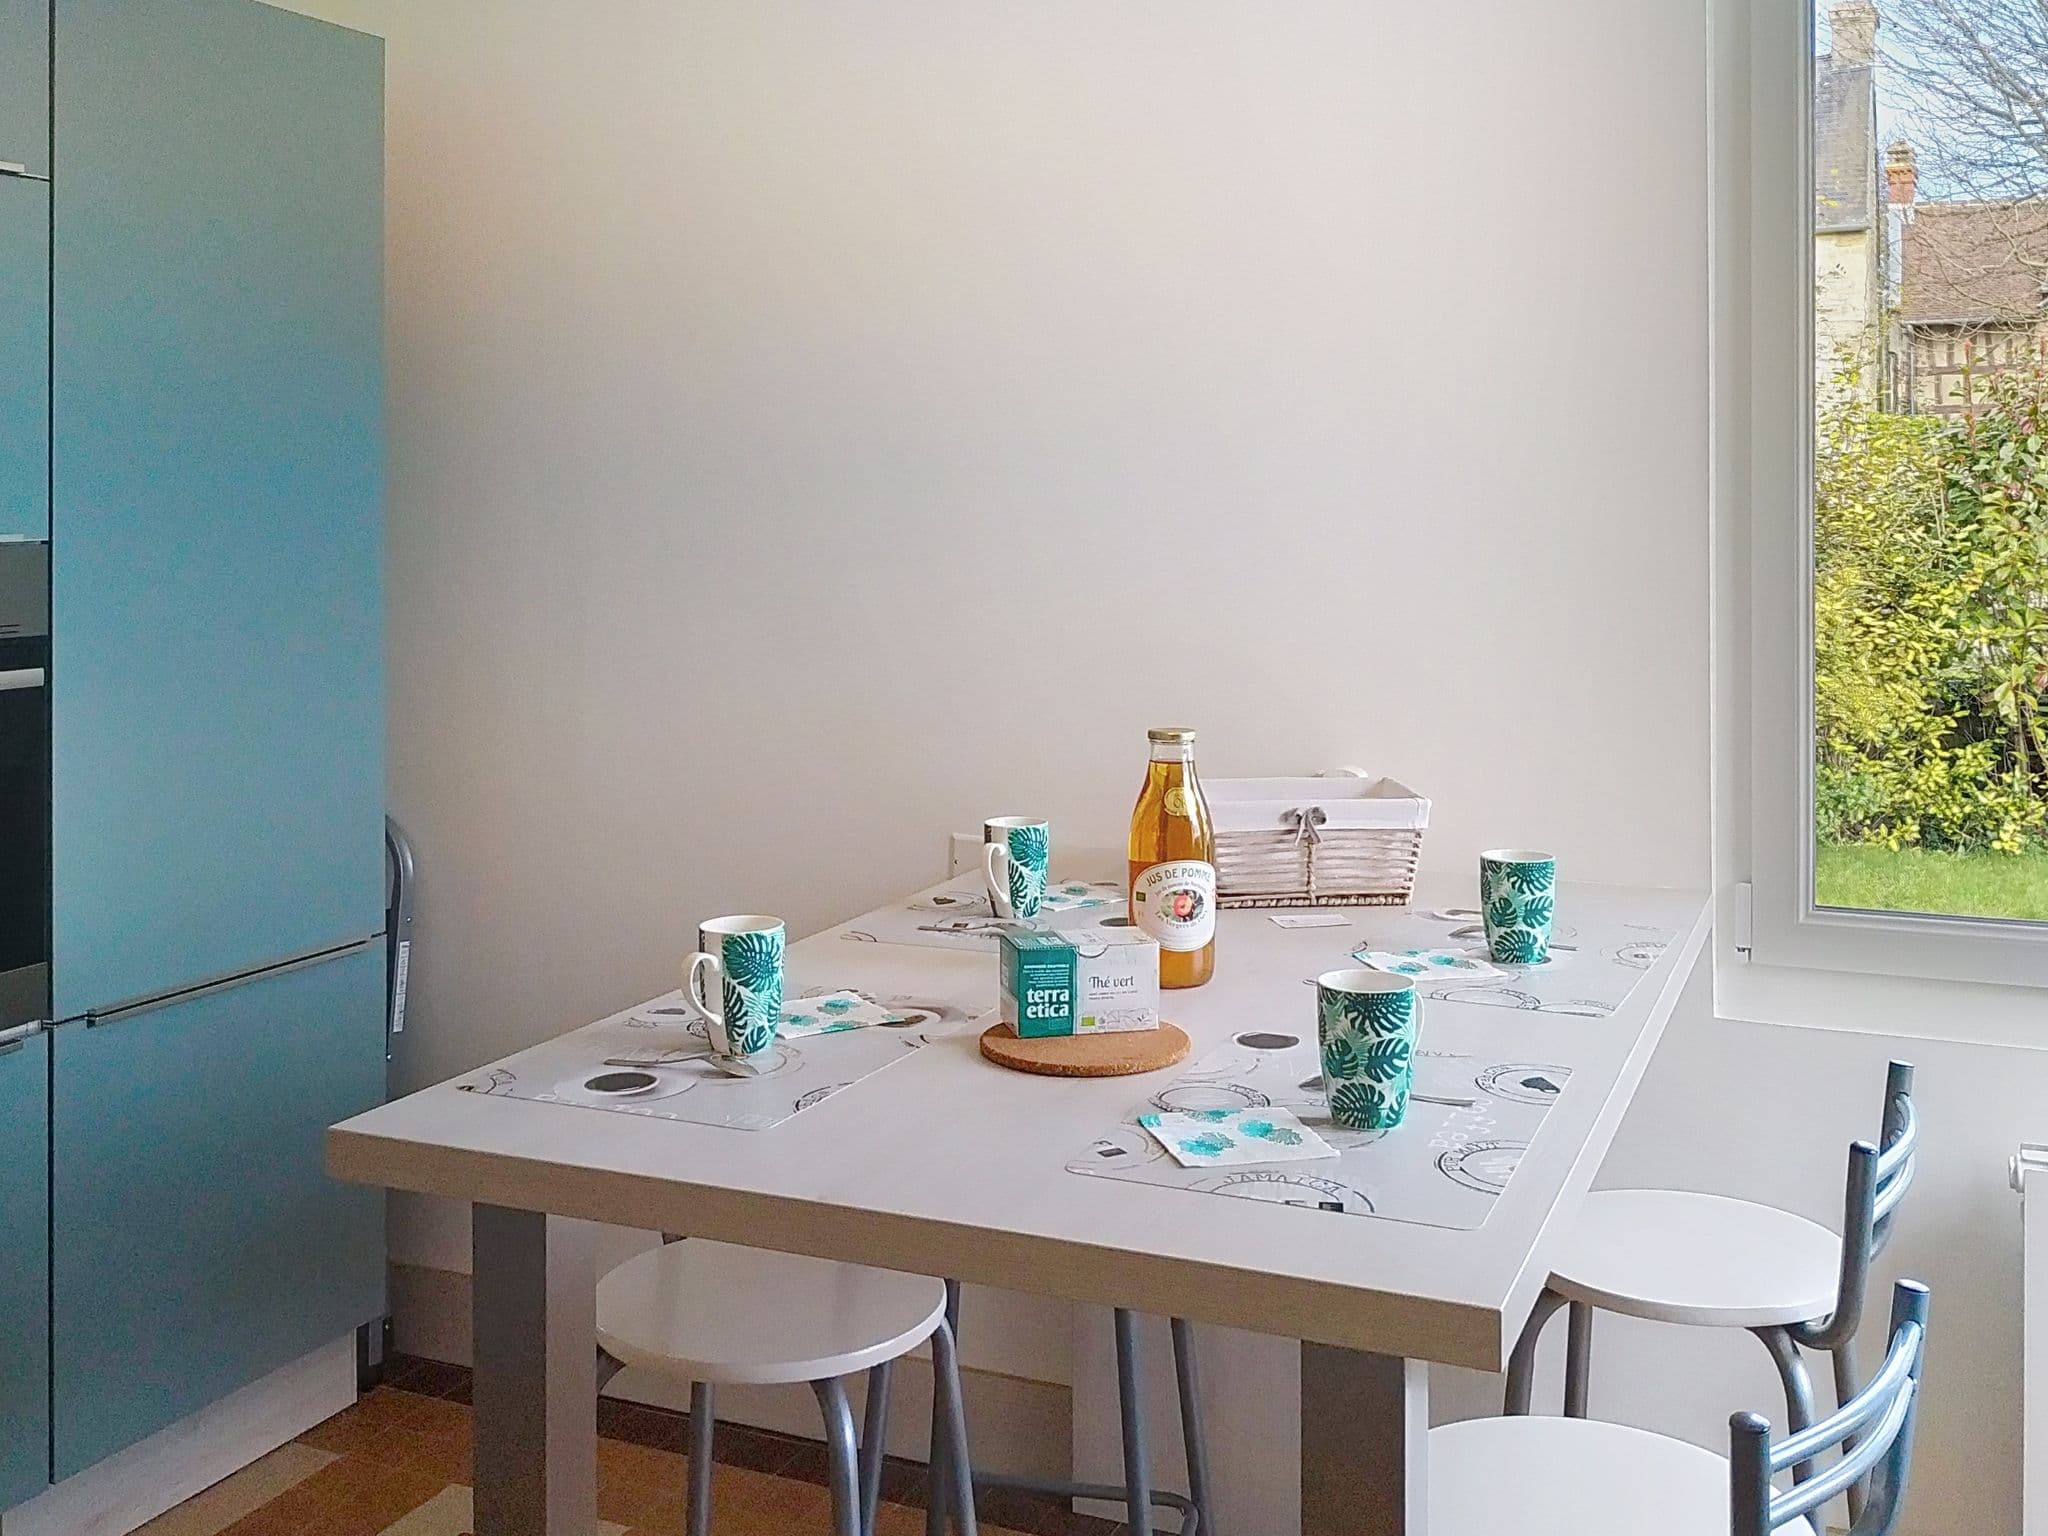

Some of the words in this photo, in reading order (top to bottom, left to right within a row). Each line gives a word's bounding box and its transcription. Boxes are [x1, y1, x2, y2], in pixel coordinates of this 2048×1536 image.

[1146, 871, 1163, 887] JUS
[1164, 868, 1178, 880] DE
[1088, 976, 1110, 989] Thé
[1113, 975, 1134, 988] vert
[1026, 988, 1069, 1003] terra
[1026, 1003, 1069, 1018] etica
